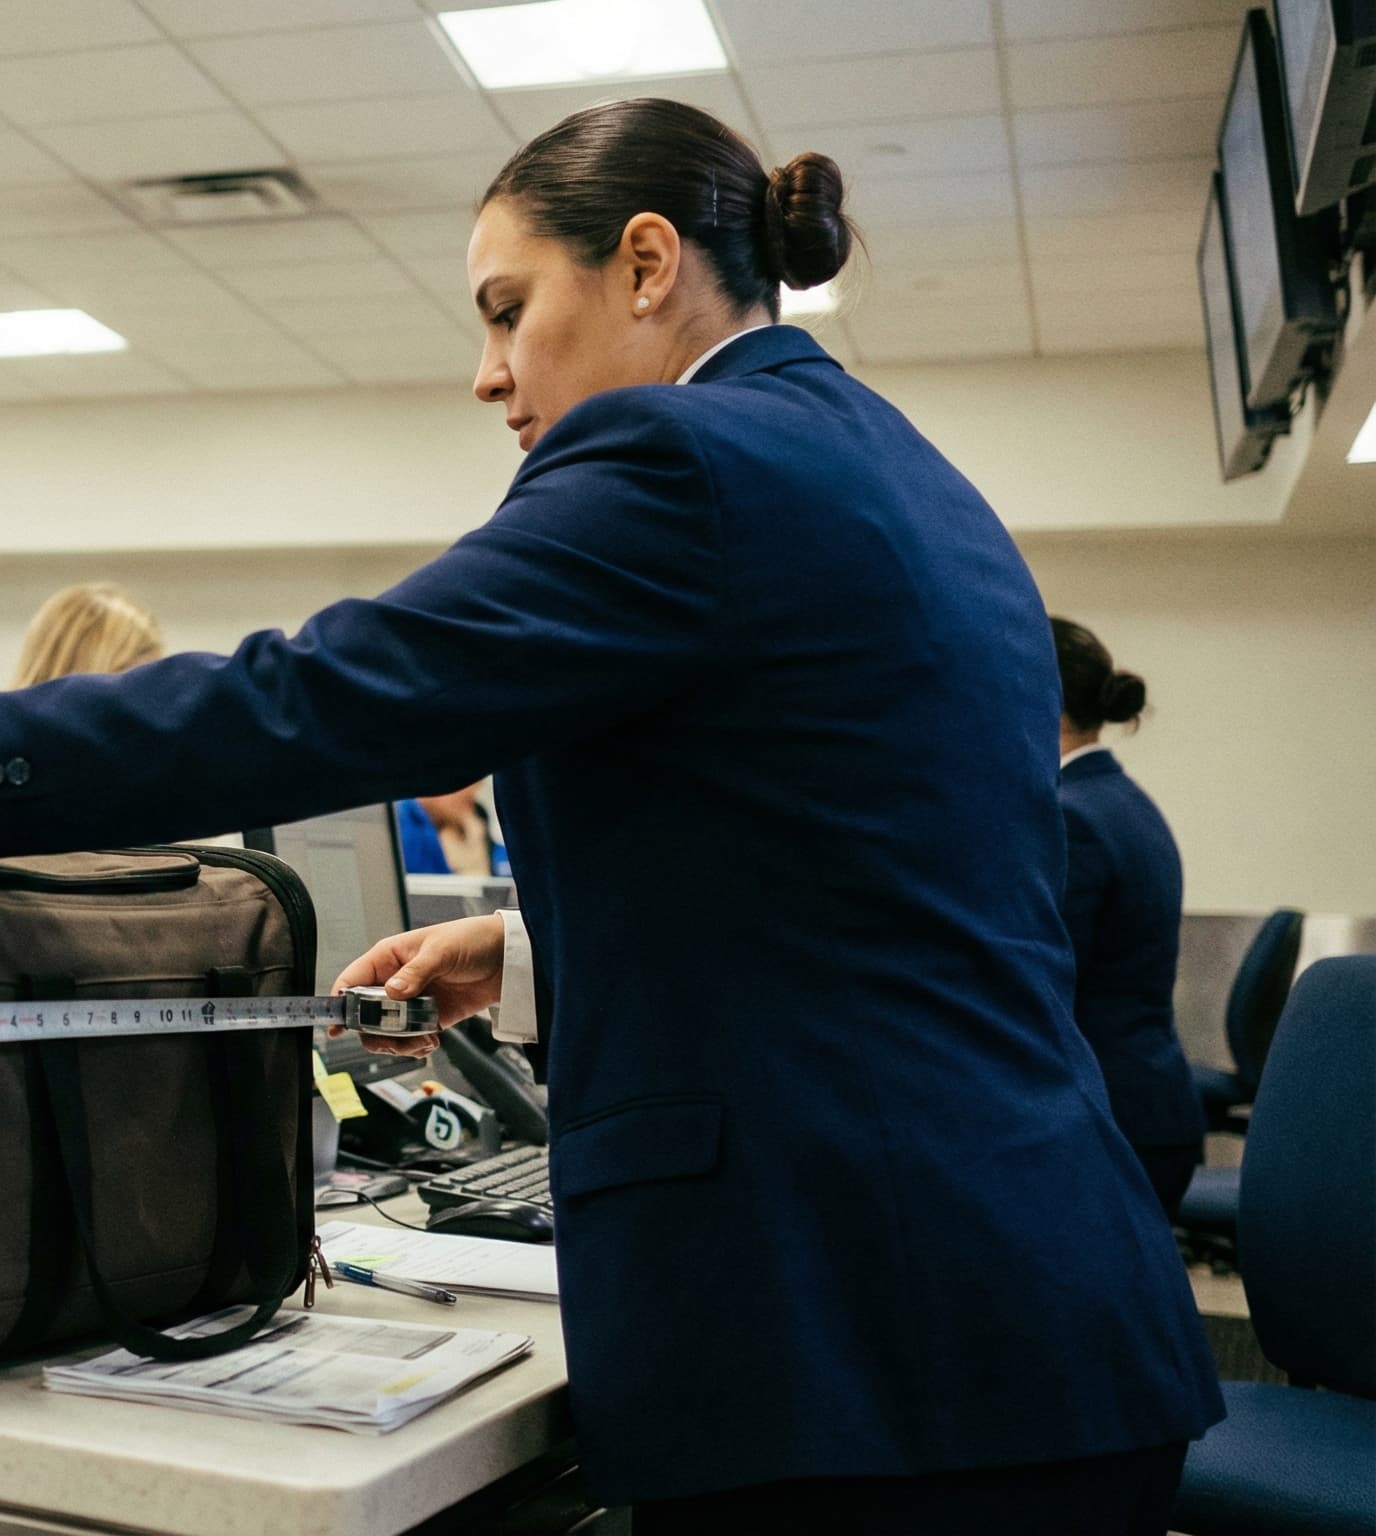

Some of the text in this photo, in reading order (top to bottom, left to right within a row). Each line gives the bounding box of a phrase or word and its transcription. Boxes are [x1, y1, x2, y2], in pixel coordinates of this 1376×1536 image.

[10, 1014, 18, 1027] 4
[36, 1013, 44, 1027] 5
[62, 1012, 70, 1026] 6
[87, 1012, 94, 1024] 7
[111, 1011, 118, 1024] 8
[134, 1010, 141, 1023] 9
[159, 1009, 173, 1023] 10
[182, 1009, 192, 1021] 11
